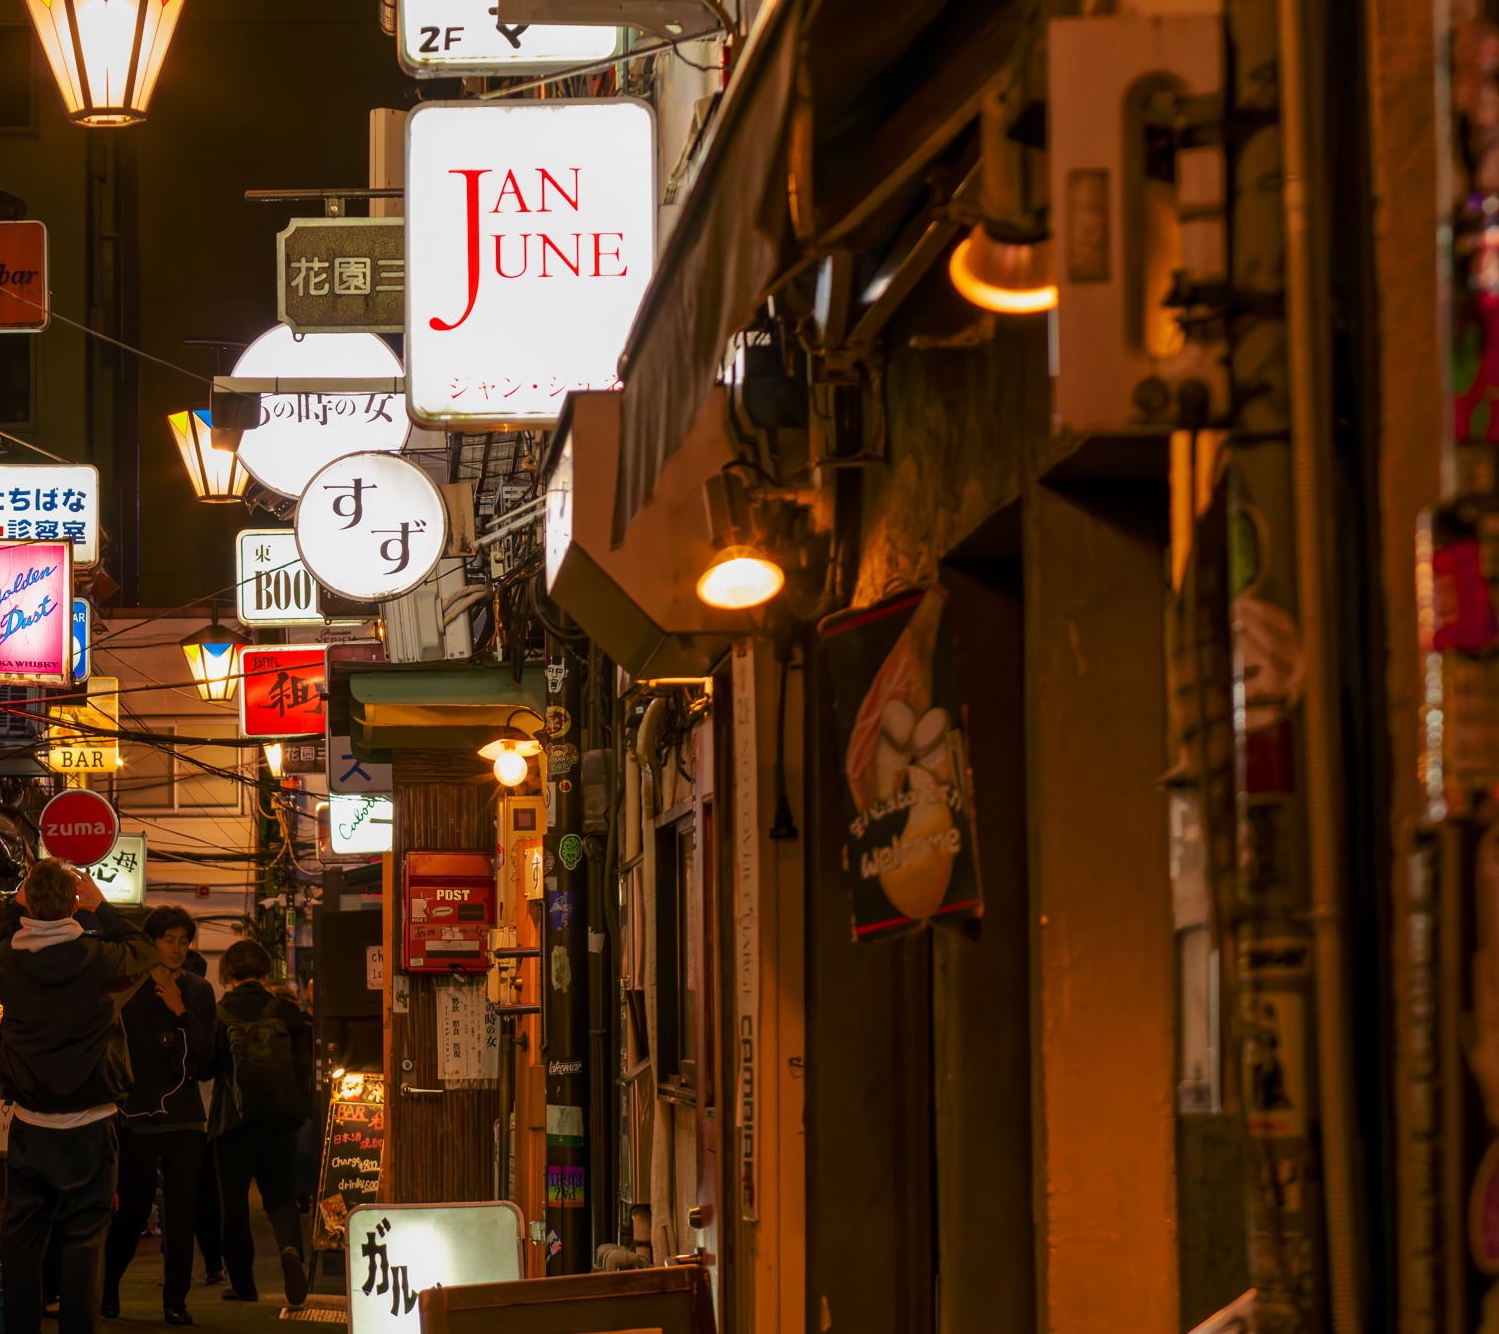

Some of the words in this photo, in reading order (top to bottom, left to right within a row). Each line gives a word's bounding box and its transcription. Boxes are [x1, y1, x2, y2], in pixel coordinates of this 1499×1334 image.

[419, 26, 465, 53] 2F
[8, 519, 87, 545] 診察室
[323, 477, 428, 576] すず
[254, 568, 316, 611] BOO
[73, 612, 86, 623] AR
[15, 660, 60, 669] WHISKY
[61, 750, 105, 769] BAR
[46, 821, 113, 837] zuma.
[436, 889, 471, 901] POST
[484, 1001, 498, 1048] の時の女
[336, 1104, 367, 1120] BAR
[333, 1131, 362, 1145] 日本酒
